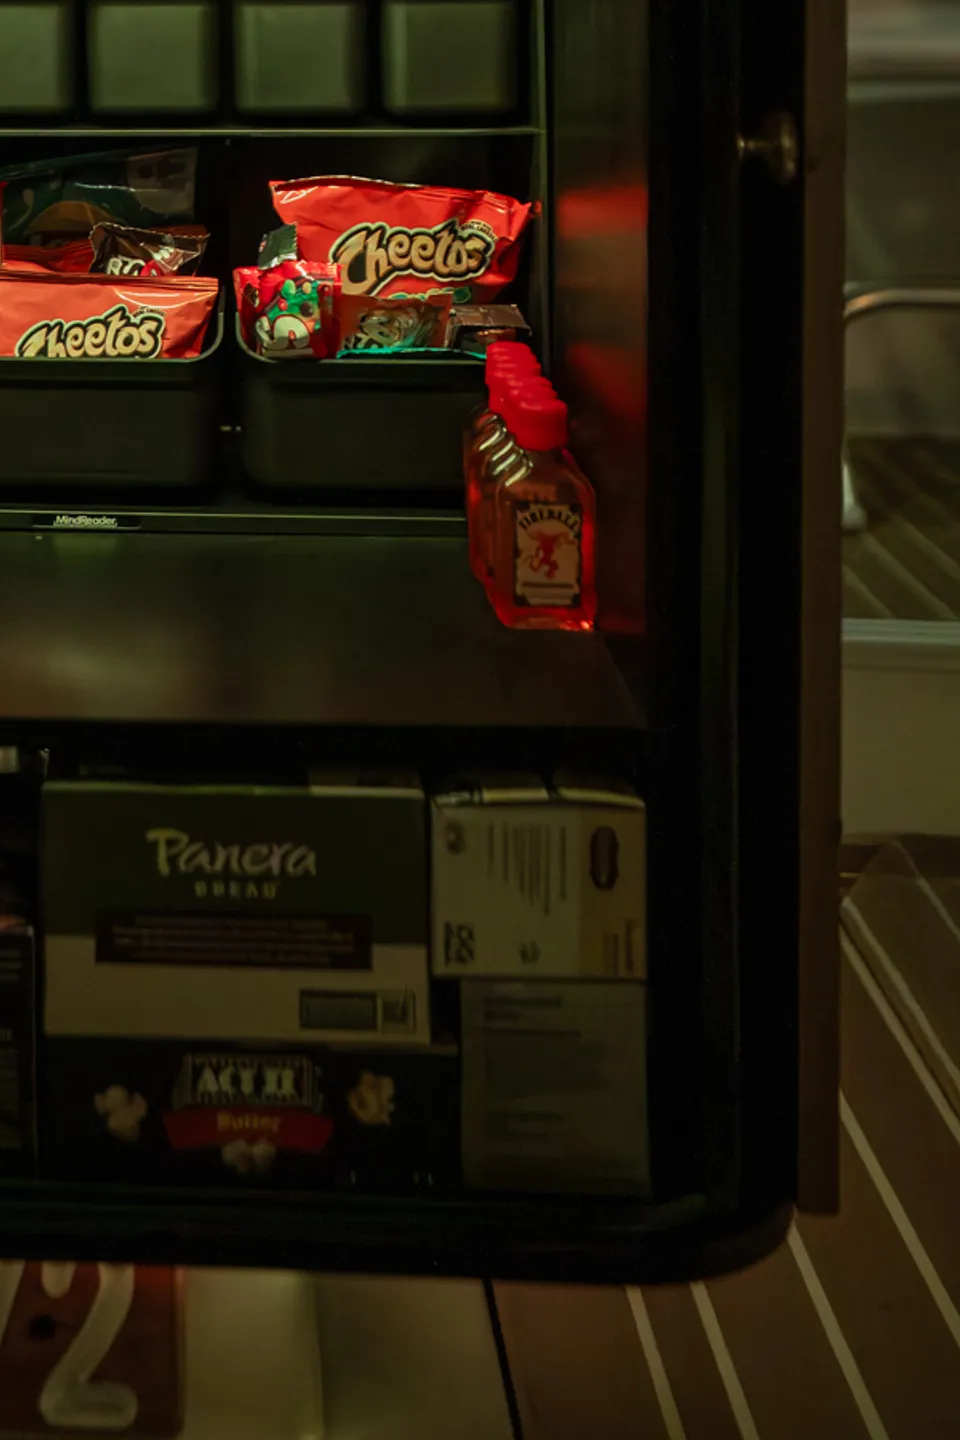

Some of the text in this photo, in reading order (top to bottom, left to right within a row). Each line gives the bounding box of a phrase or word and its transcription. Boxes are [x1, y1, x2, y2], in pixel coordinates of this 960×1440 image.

[330, 217, 496, 296] Cheetos
[55, 514, 117, 526] MindReader
[145, 825, 318, 878] Panera
[193, 880, 278, 900] BREAD
[196, 1063, 298, 1094] ACT II
[215, 1110, 283, 1133] Butter
